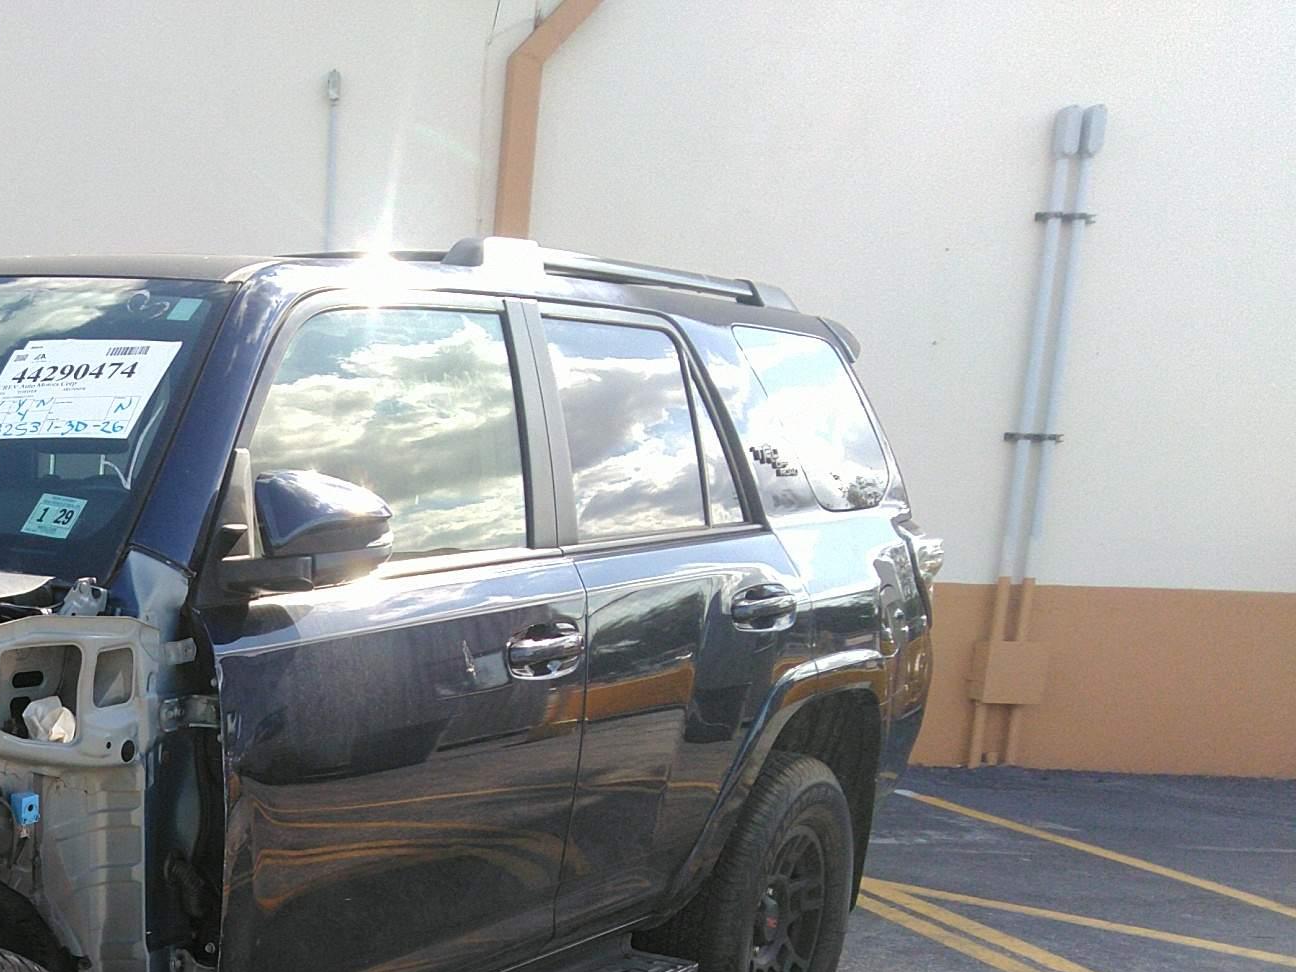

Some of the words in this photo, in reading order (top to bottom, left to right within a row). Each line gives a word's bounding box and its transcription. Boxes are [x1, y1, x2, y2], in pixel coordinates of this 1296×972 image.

[12, 361, 139, 384] 44290474
[36, 507, 50, 522] 1
[53, 508, 75, 526] 29
